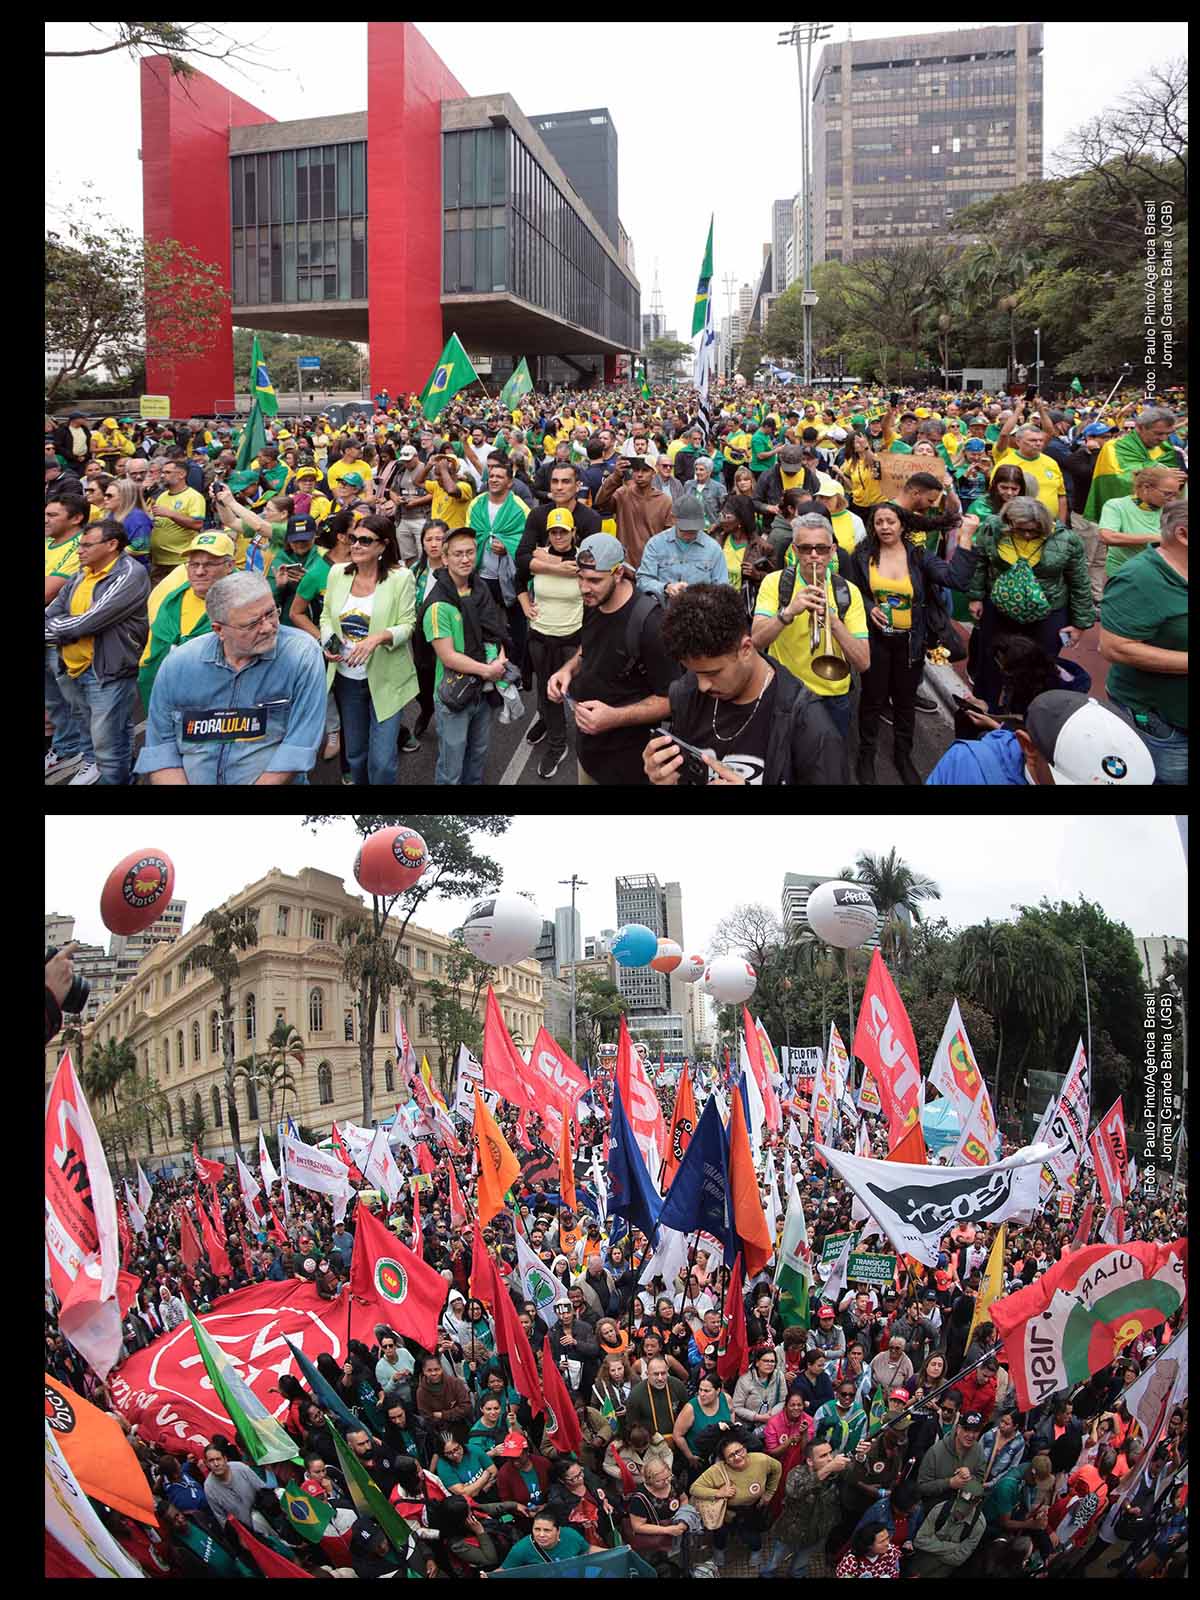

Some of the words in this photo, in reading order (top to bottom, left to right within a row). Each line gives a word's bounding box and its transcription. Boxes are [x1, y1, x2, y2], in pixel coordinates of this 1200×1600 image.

[186, 717, 250, 735] #FORALULA!
[394, 846, 427, 868] SINDICA
[123, 879, 167, 907] SINDICAL
[790, 1049, 806, 1060] PELO
[807, 1048, 818, 1059] FIM
[870, 993, 921, 1101] CUT
[852, 1264, 891, 1273] ENERGÉTICA
[855, 1258, 890, 1268] TRANSIÇÃO
